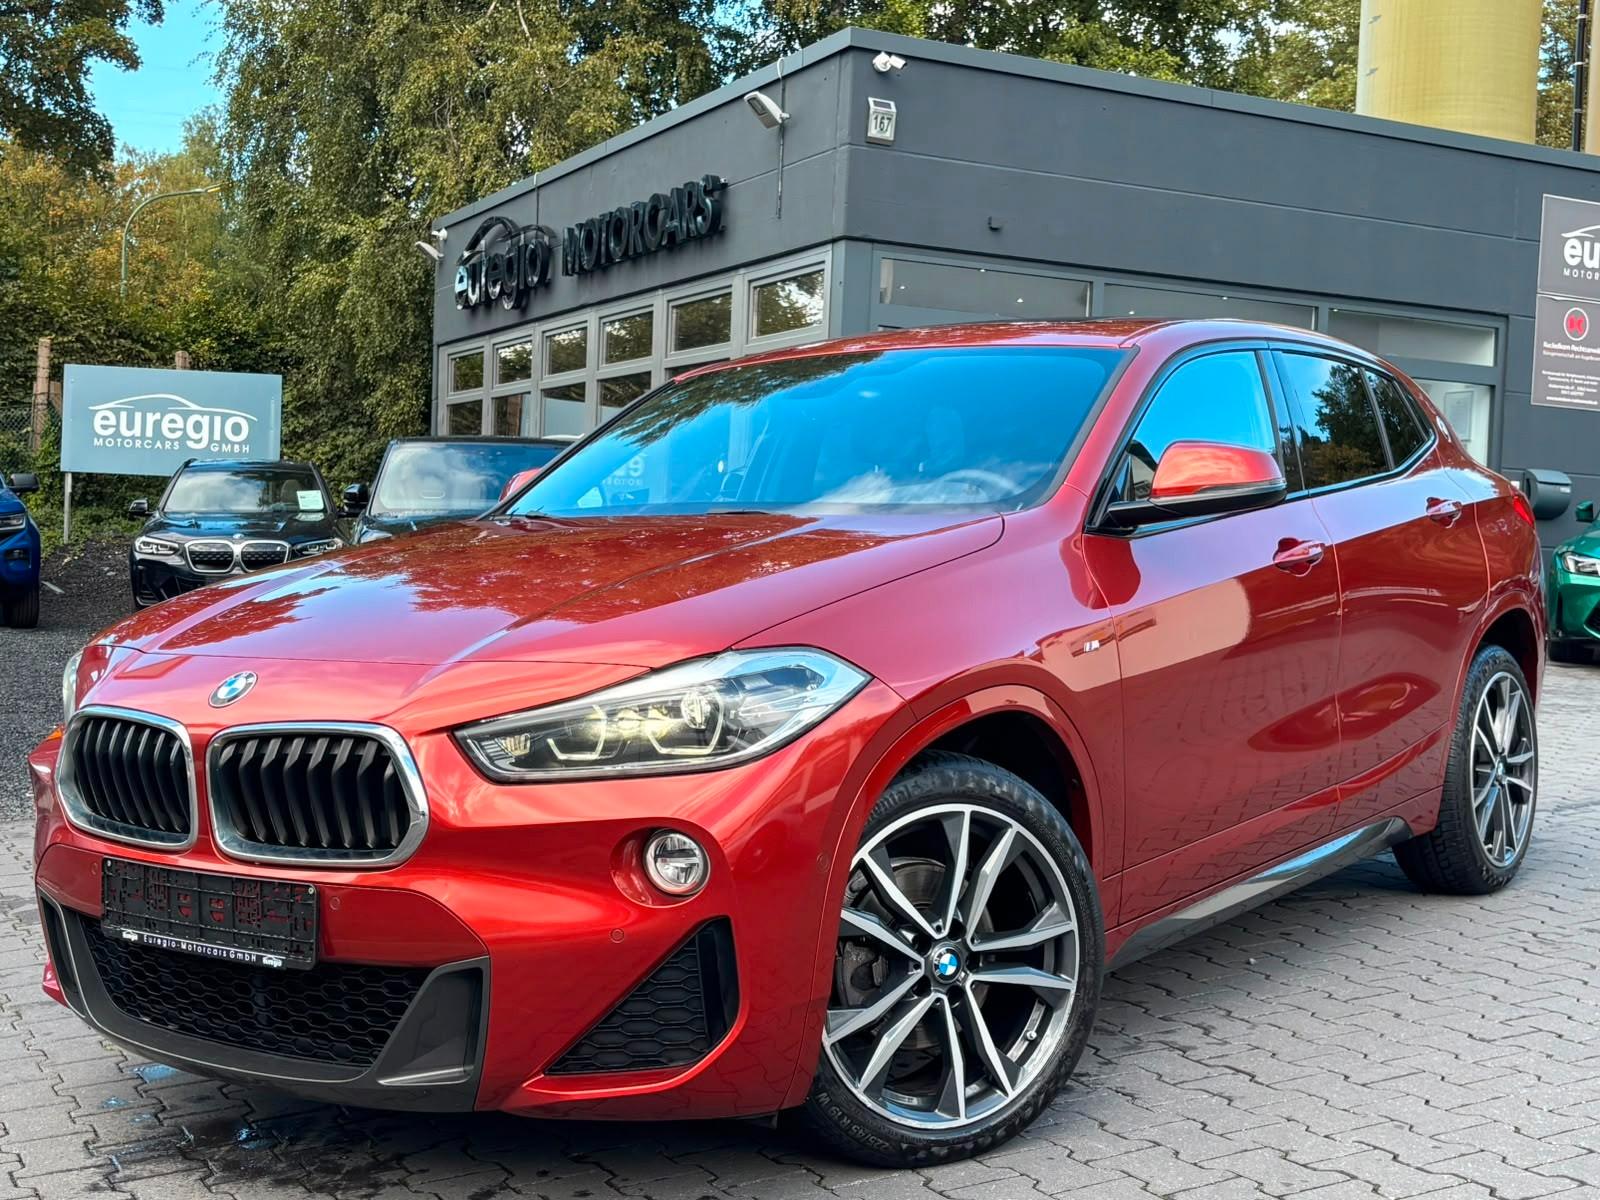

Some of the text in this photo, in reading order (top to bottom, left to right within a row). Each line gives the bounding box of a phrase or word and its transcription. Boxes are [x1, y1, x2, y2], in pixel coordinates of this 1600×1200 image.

[874, 114, 892, 132] 167
[454, 174, 727, 311] euregio MOTORCARS
[93, 409, 249, 449] euregio
[93, 437, 250, 454] MOTORCARS GMBH
[143, 934, 227, 958] Euregio-Motorcars
[229, 949, 257, 963] GmbH
